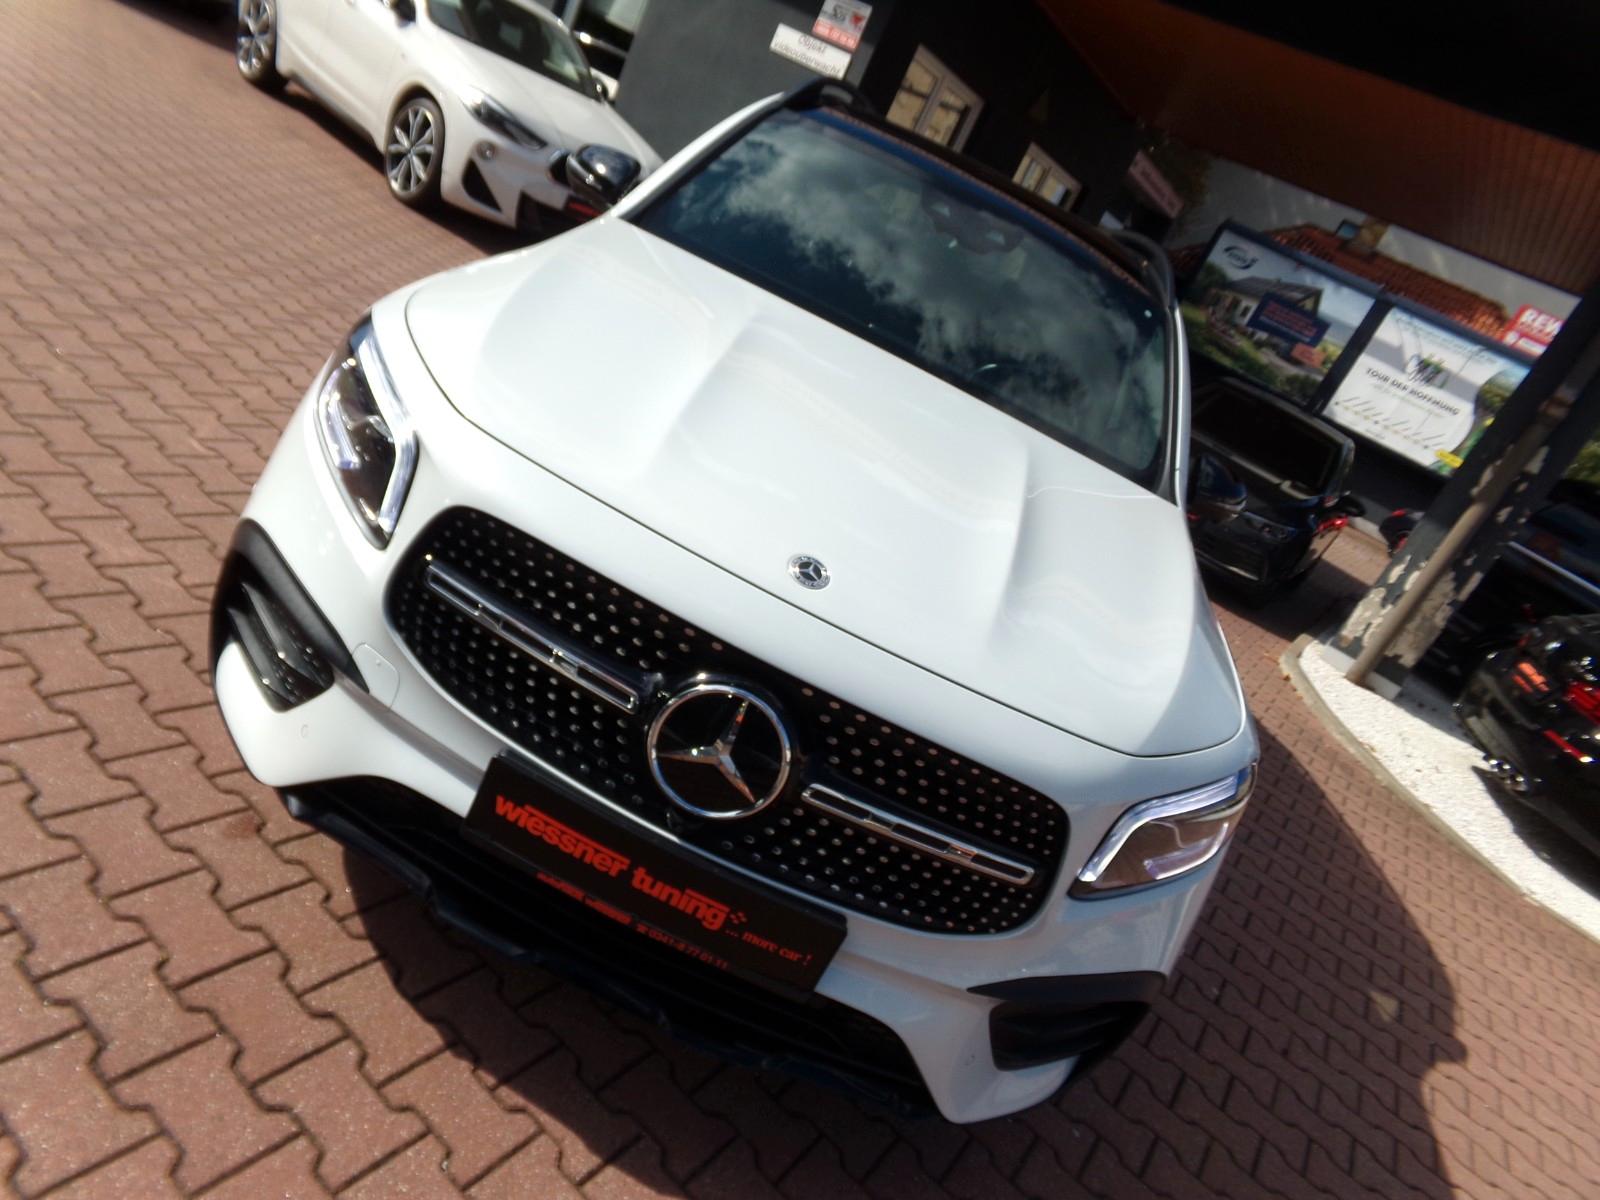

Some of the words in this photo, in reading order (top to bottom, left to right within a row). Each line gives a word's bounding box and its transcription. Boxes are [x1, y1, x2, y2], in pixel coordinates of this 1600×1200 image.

[1366, 367, 1391, 382] TOUR
[1391, 378, 1409, 392] DER
[1409, 388, 1461, 416] HOFFNUNG
[495, 795, 631, 877] wiessner
[631, 866, 730, 931] tuning
[743, 931, 779, 952] more
[779, 947, 802, 962] car
